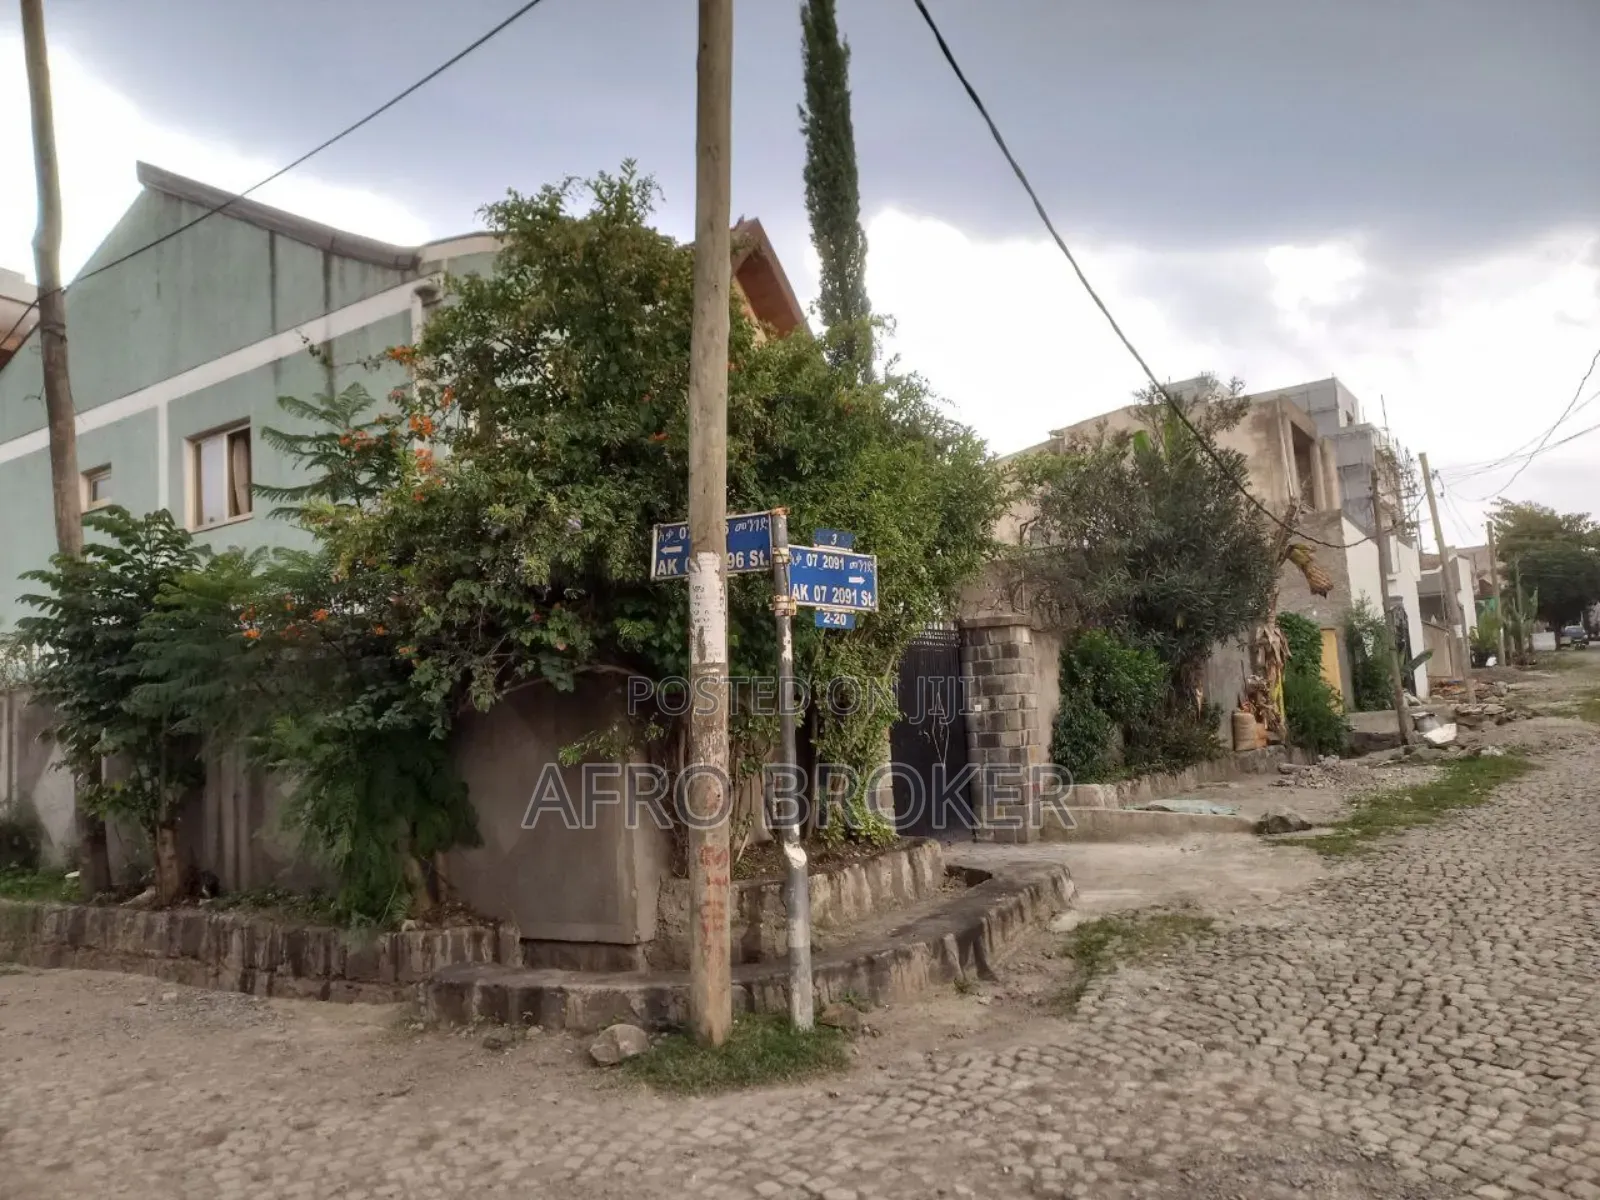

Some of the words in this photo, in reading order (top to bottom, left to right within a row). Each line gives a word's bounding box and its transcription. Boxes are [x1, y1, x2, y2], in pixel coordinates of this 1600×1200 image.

[830, 533, 837, 545] 3
[657, 558, 678, 575] AK
[749, 549, 769, 567] St.
[792, 583, 809, 600] AK
[813, 585, 827, 601] 07
[832, 587, 857, 605] 2091
[861, 589, 875, 606] St.
[823, 612, 846, 626] 2-20
